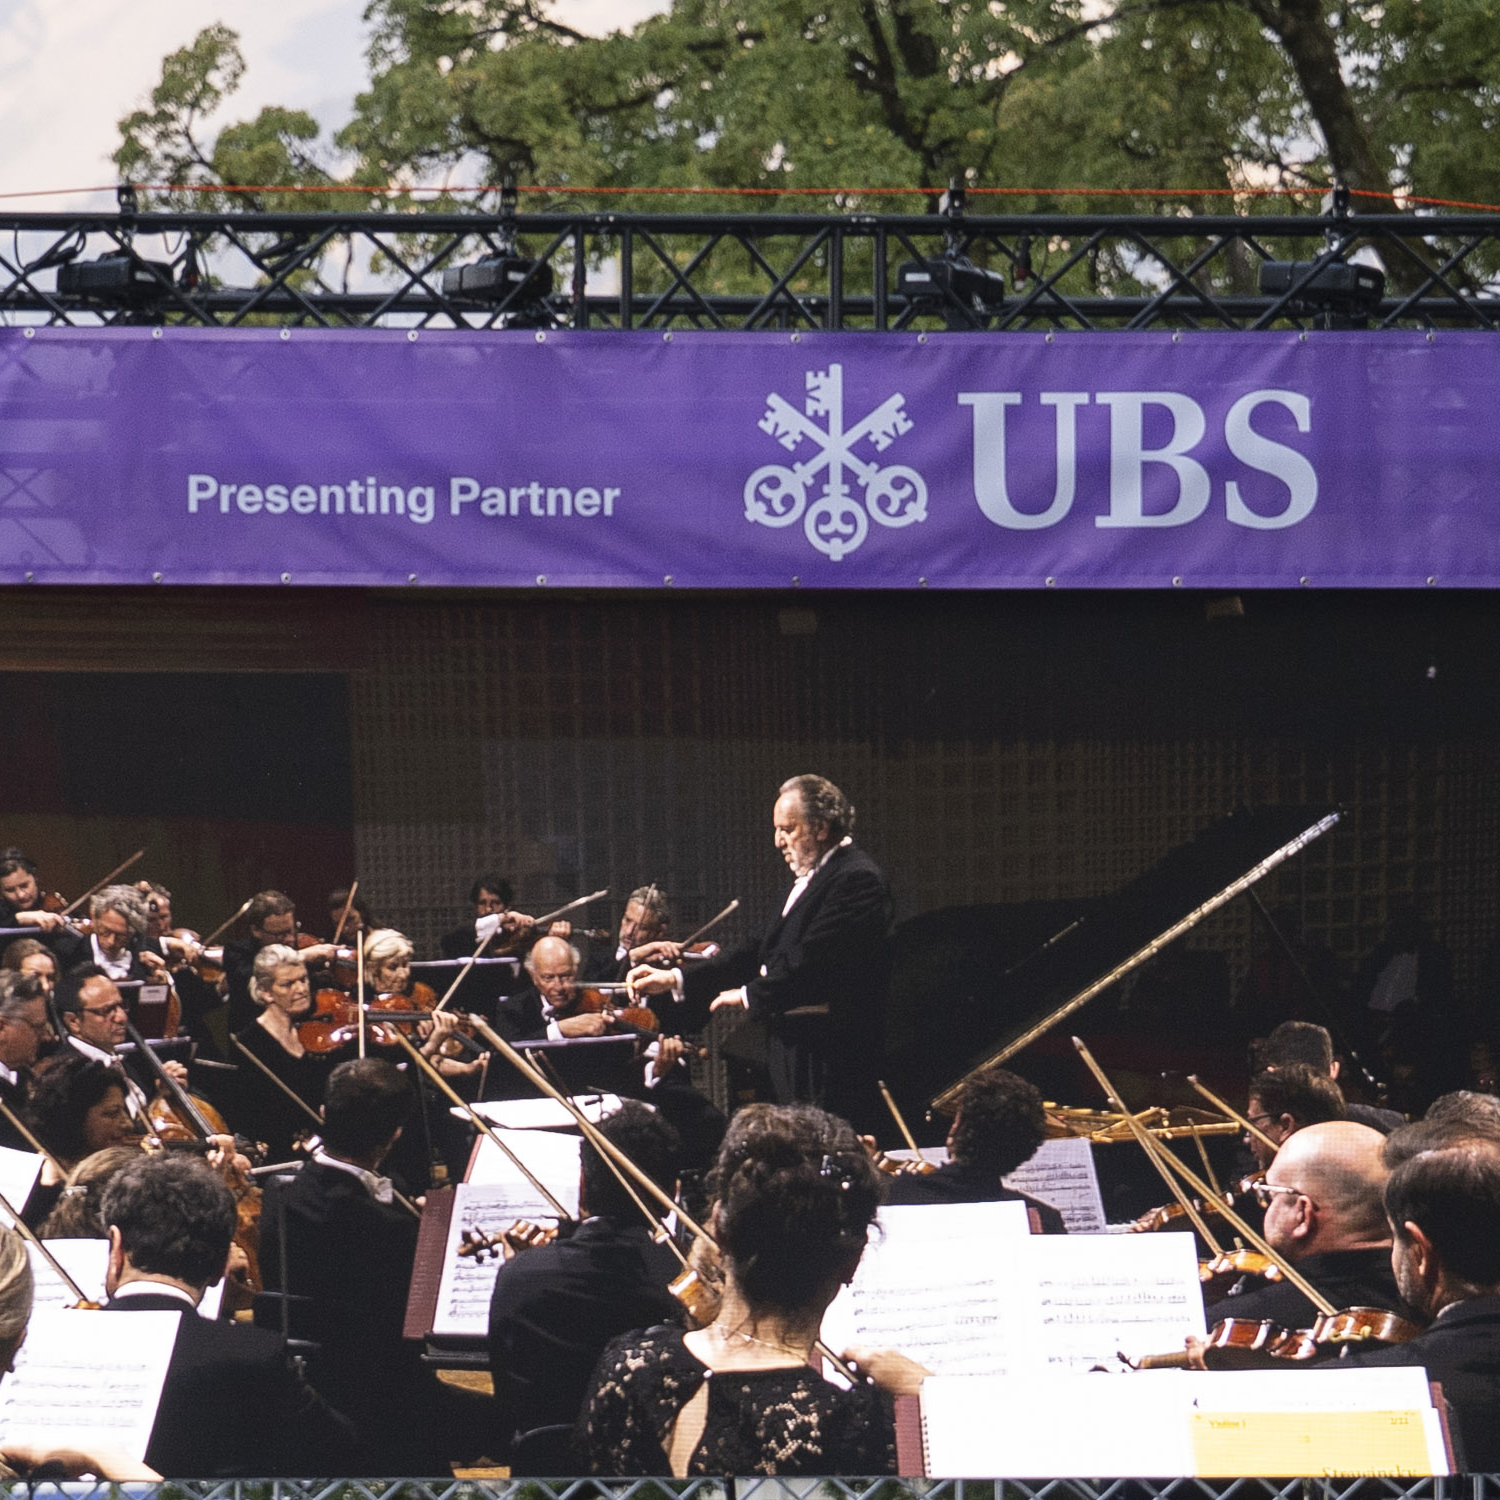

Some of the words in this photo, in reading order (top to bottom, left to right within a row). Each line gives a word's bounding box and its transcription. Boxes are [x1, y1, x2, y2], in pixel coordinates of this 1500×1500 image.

[187, 474, 435, 524] Presenting
[450, 477, 621, 517] Partner
[957, 389, 1318, 531] UBS
